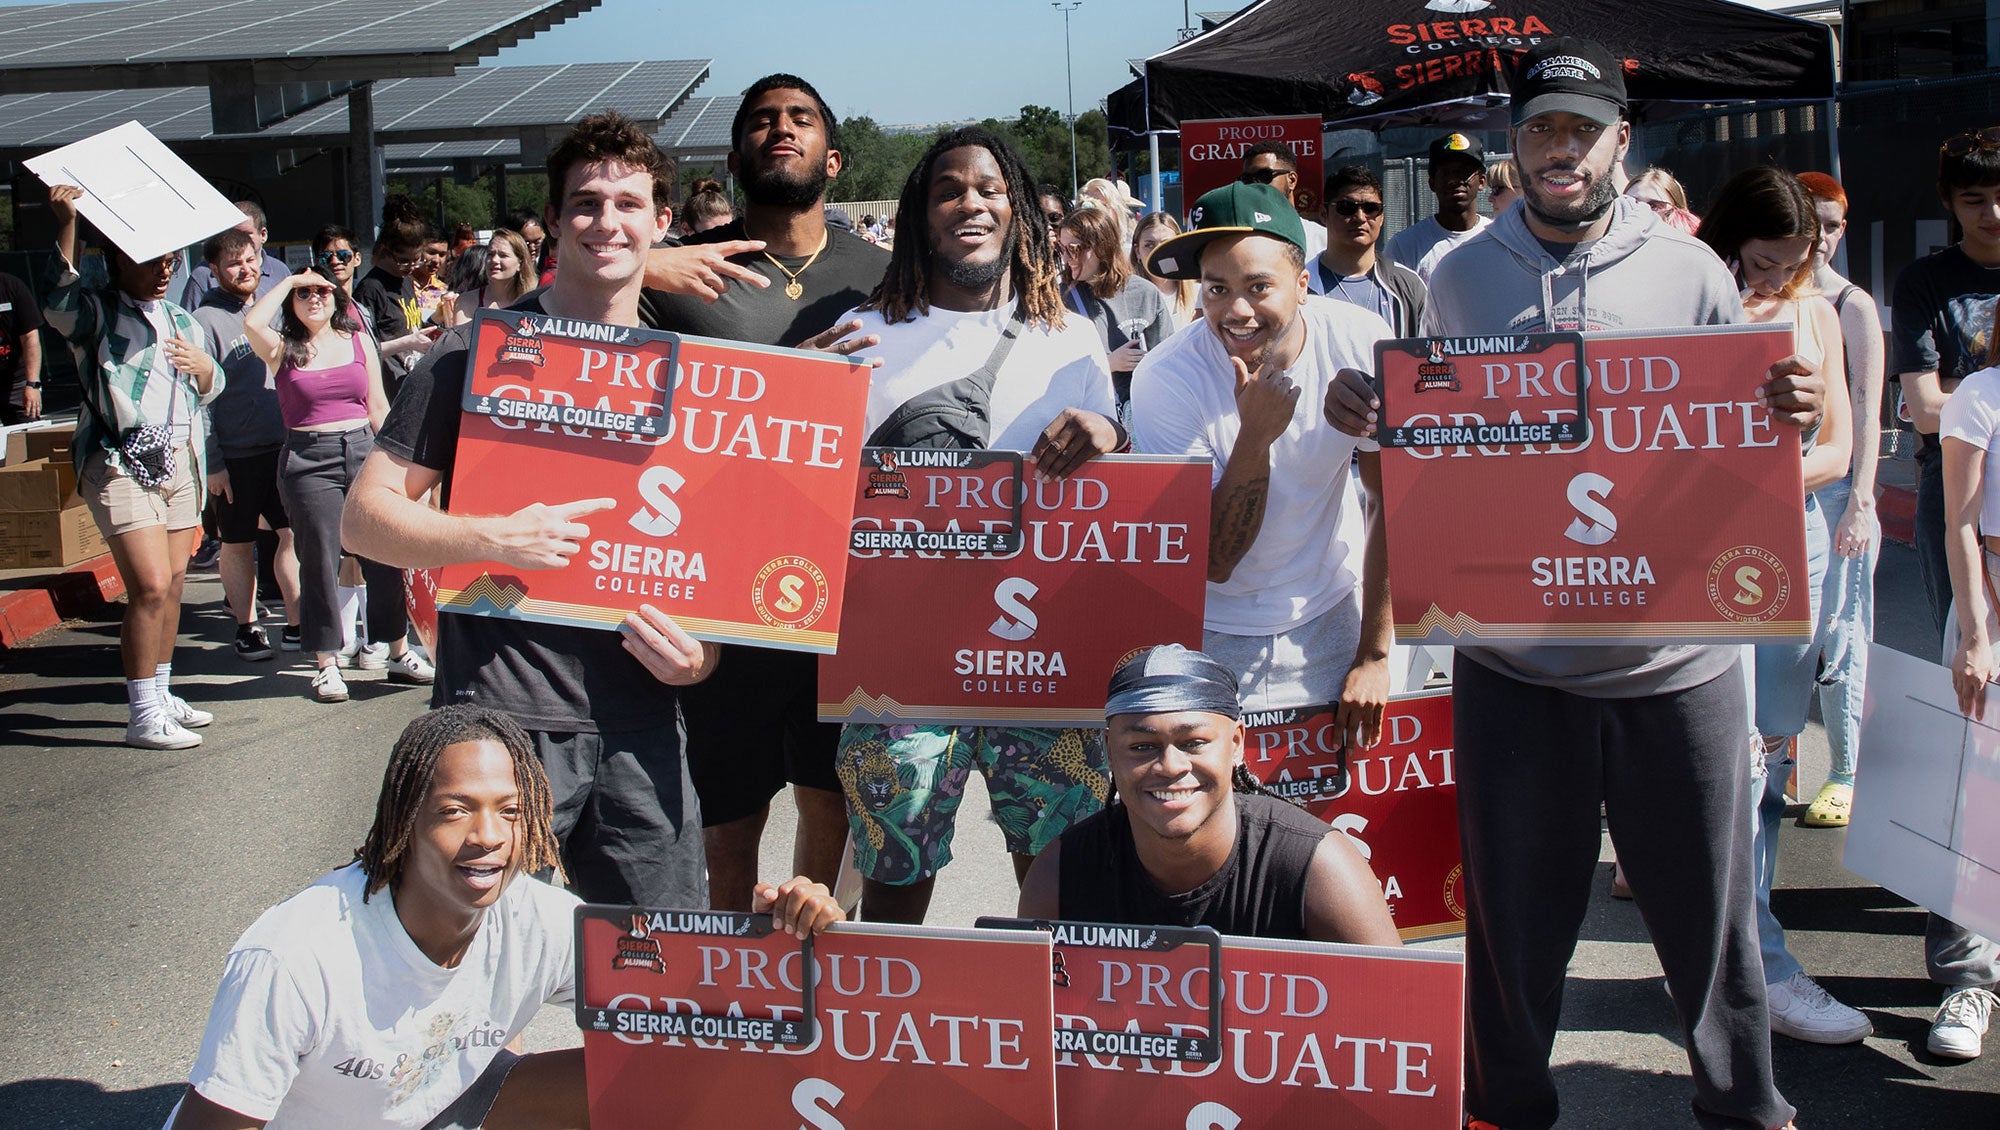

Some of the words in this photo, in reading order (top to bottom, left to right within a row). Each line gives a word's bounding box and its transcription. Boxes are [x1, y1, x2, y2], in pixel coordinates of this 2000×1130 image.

[1386, 15, 1553, 45] SIERRA
[1395, 47, 1502, 90] SIERRA
[1526, 55, 1601, 80] SACRAMENTO
[1218, 124, 1286, 141] PROUD
[1189, 139, 1316, 161] GRADTE
[506, 336, 541, 349] SIERRA
[541, 318, 617, 343] ALUMNI
[508, 346, 538, 354] COLLEGE
[509, 352, 535, 361] ALUMNI
[1442, 336, 1516, 355] ALUMNI
[576, 346, 767, 403] PROUD
[1419, 364, 1454, 375] SIERRA
[1481, 356, 1681, 400] PROUD
[497, 399, 559, 422] SIERRA
[563, 407, 637, 431] COLLEGE
[1413, 428, 1475, 445] SIERRA
[1479, 425, 1552, 443] COLLEGE
[893, 451, 958, 467] LUMNI
[870, 473, 904, 483] SIERRA
[924, 475, 1109, 511] PROUD
[854, 533, 914, 549] SIERRA
[917, 533, 988, 550] COLLEGE
[588, 539, 707, 583] SIERRA
[760, 558, 789, 580] SIERRA
[793, 558, 825, 587] COLLEGE
[1531, 555, 1657, 587] SIERRA
[1712, 549, 1741, 575] SIERRA
[1745, 548, 1784, 574] COLLEGE
[595, 574, 695, 601] COLLEGE
[1543, 590, 1647, 607] COLLEGE
[954, 648, 1068, 677] SIERRA
[962, 679, 1057, 694] COLLEGE
[1242, 710, 1285, 729] UMNI
[650, 911, 735, 935] ALUMNI
[619, 939, 657, 953] SIERRA
[1054, 925, 1140, 949] ALUMNI
[624, 957, 653, 967] ALUMNI
[697, 945, 922, 998] PROUD
[1097, 960, 1330, 1019] PROUD
[617, 1011, 687, 1035] SIERRA
[691, 1017, 774, 1041] COLLEGE
[1092, 1034, 1178, 1058] COLLEGE
[333, 1056, 385, 1080] 40s
